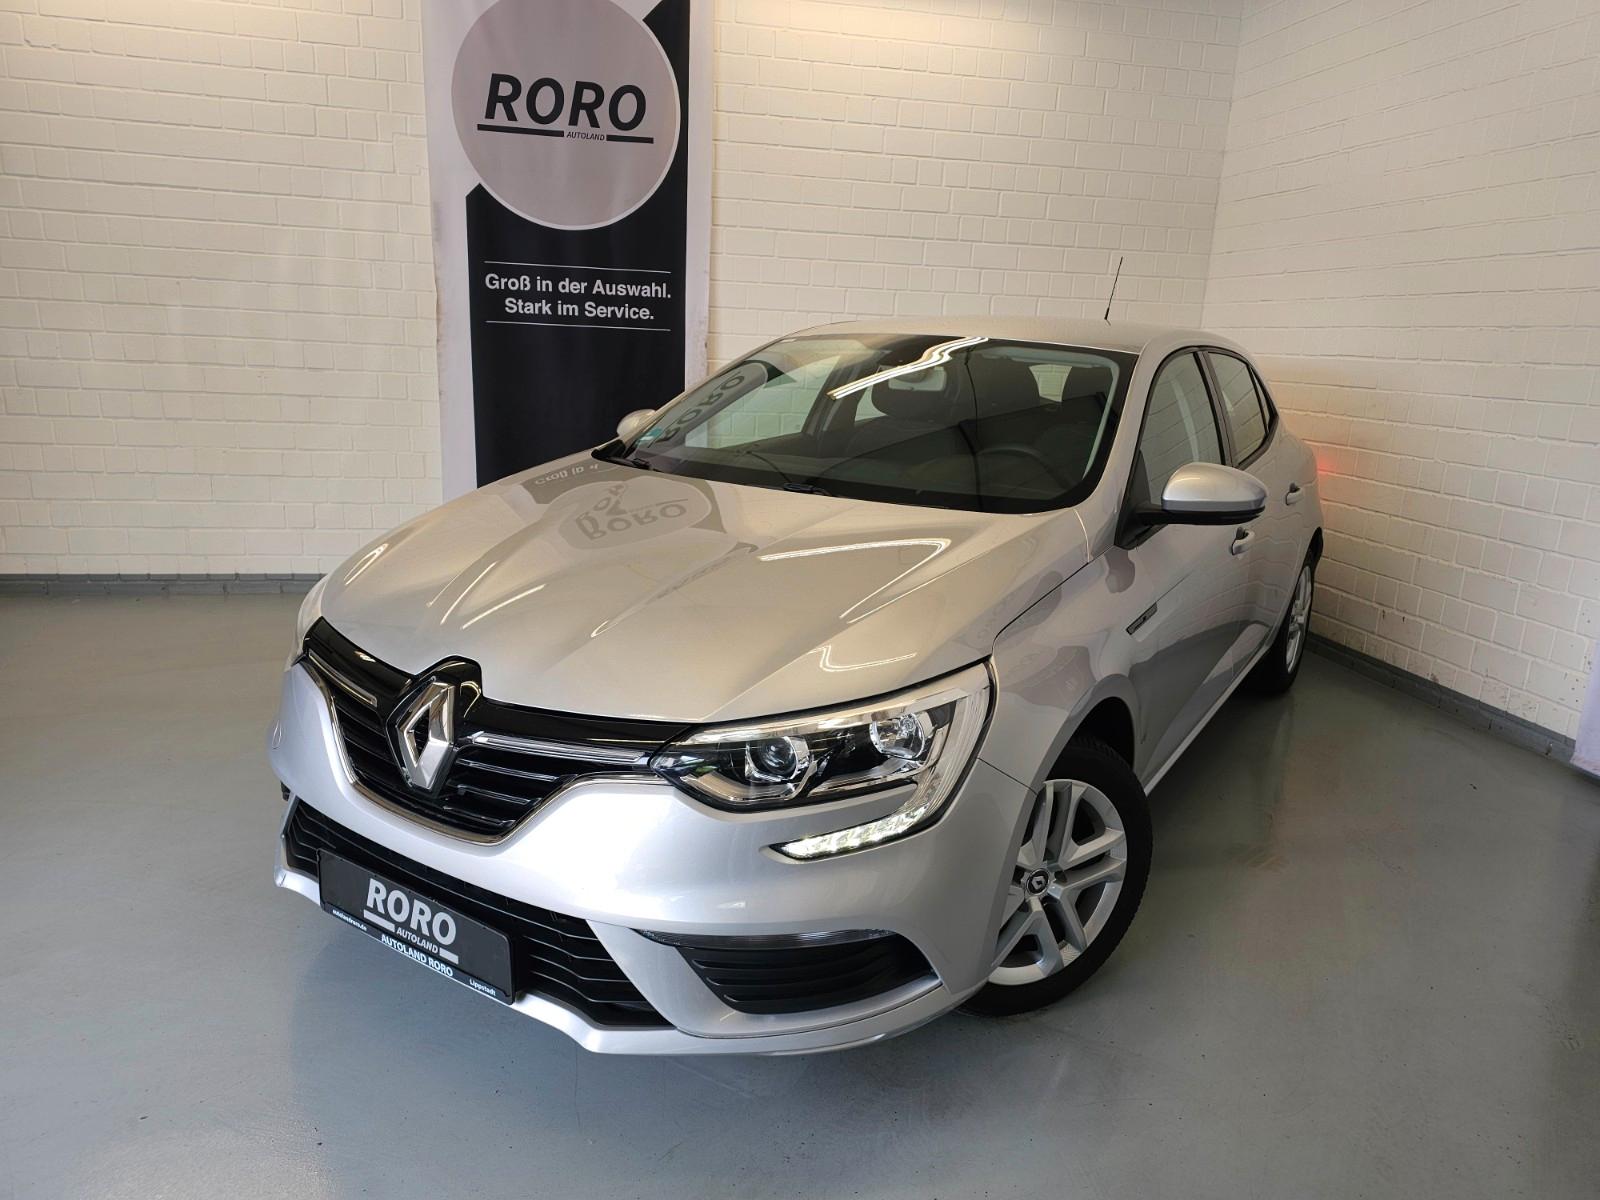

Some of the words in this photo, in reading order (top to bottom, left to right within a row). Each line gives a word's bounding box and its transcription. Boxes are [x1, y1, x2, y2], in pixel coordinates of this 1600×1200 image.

[484, 73, 647, 131] RORO
[566, 131, 605, 141] AUTOLAND
[485, 273, 531, 291] Groß
[536, 276, 553, 292] in
[558, 277, 588, 294] der
[592, 280, 672, 298] Auswahl.
[504, 298, 552, 315] Stark
[557, 300, 579, 316] im
[584, 303, 655, 320] Service.
[366, 878, 457, 945] RORO
[396, 927, 439, 954] AUTOLAND
[381, 934, 427, 963] AUTOLAND
[428, 958, 454, 977] RORO
[469, 978, 496, 997] Lippstadt
